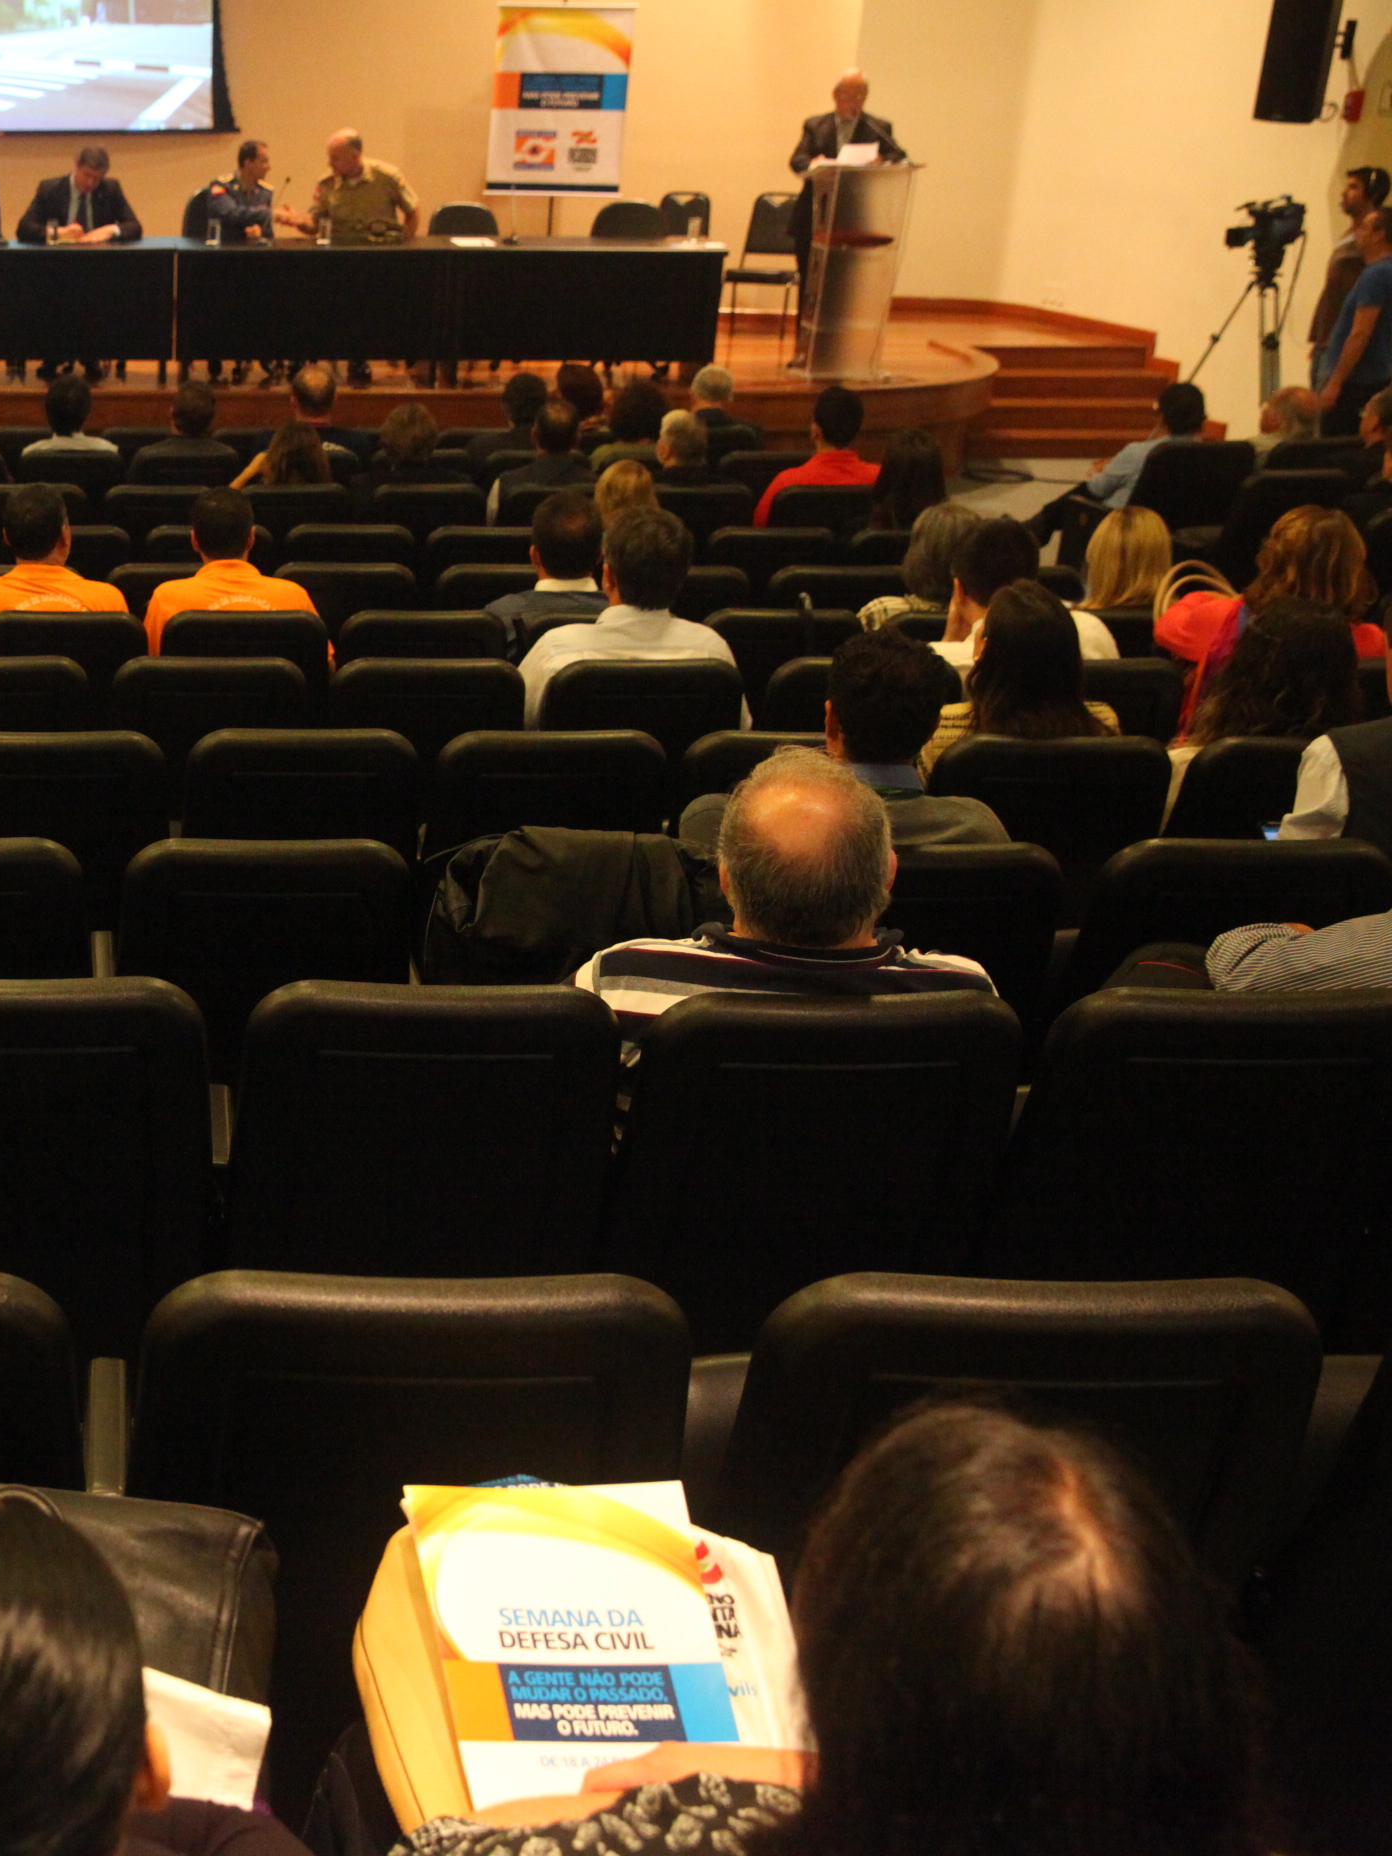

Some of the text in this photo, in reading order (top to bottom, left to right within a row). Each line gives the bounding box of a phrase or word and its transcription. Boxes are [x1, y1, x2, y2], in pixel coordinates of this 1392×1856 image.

[499, 1608, 644, 1627] SEMANA DA
[498, 1630, 655, 1651] DEFESA CIVIL
[508, 1668, 665, 1686] A GENTE NÃO PODE
[511, 1686, 668, 1703] MUDAR O PASSADO,
[513, 1703, 676, 1720] MAS PODE PREVENIR
[557, 1720, 639, 1737] O FUTURO.
[540, 1755, 557, 1768] DE
[562, 1755, 577, 1768] 18
[581, 1755, 591, 1767] A
